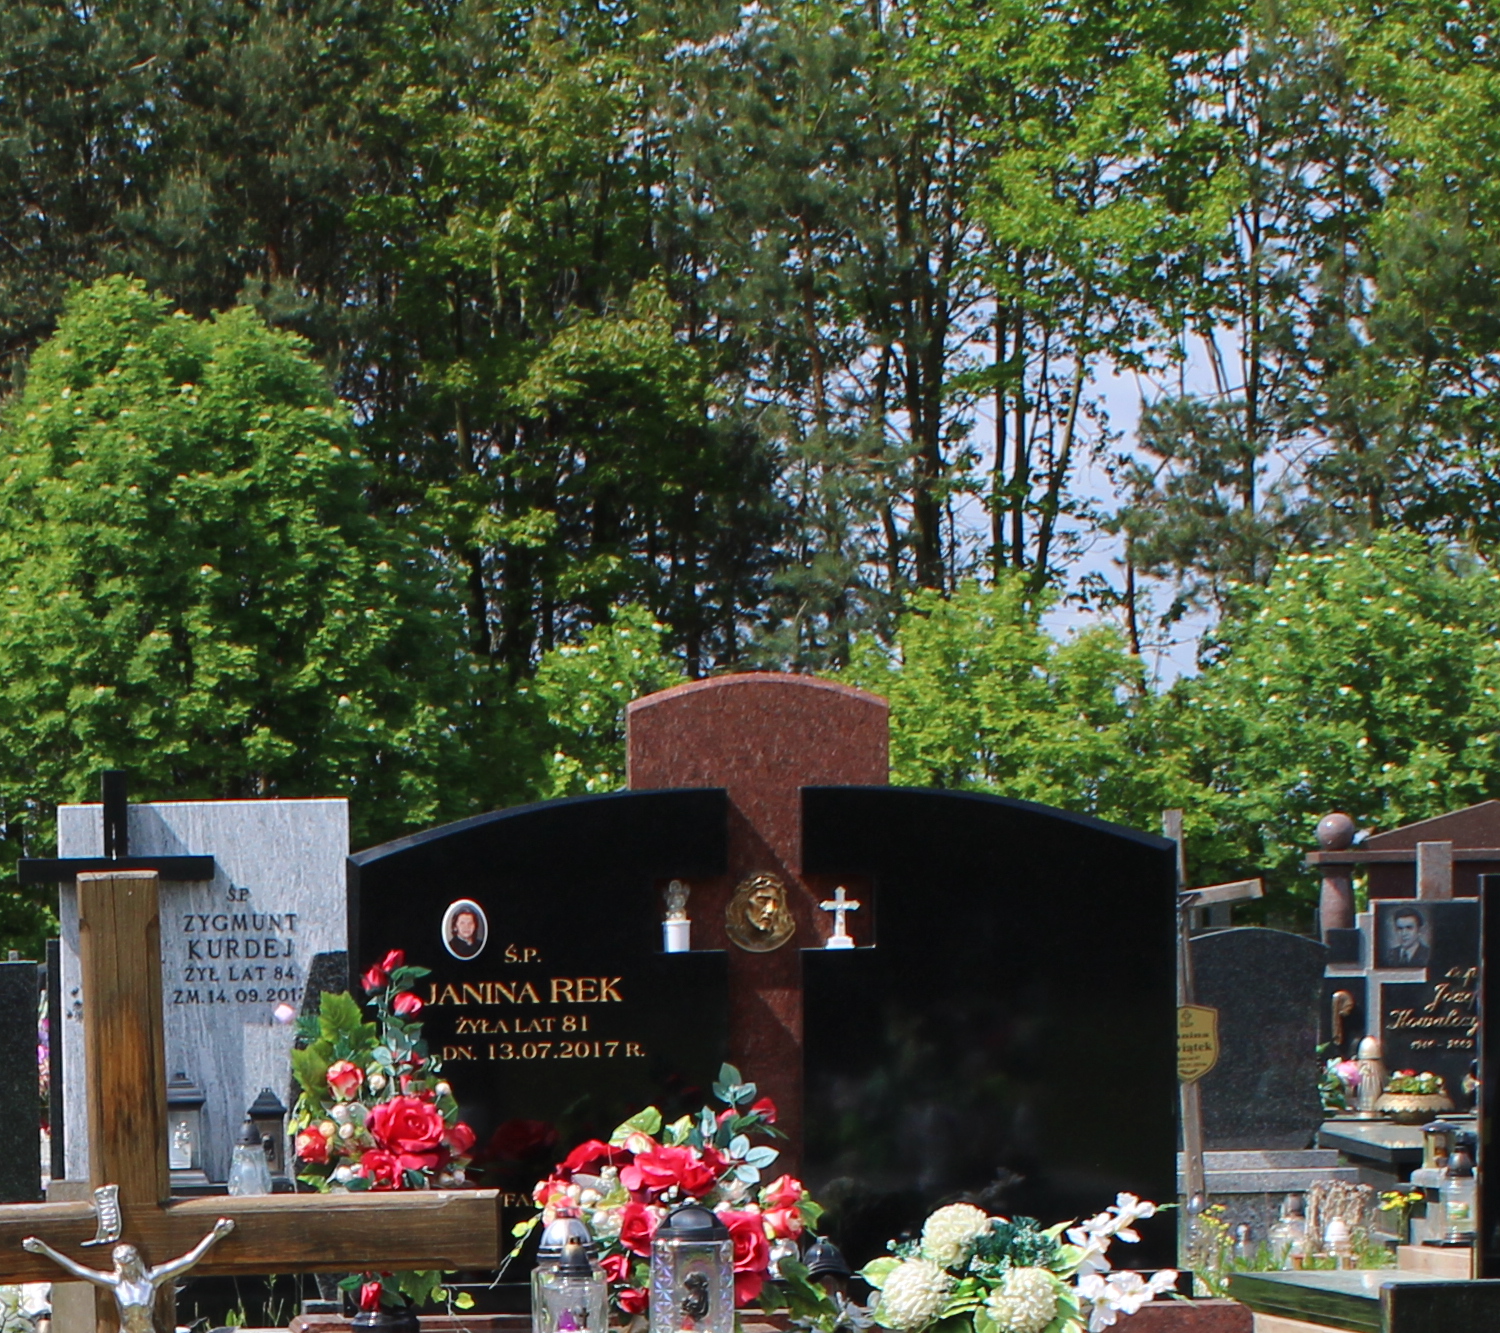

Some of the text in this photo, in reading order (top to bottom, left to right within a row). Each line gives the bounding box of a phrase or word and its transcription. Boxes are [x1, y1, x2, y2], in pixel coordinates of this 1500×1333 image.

[183, 914, 298, 932] ZYGMUNT
[188, 939, 294, 960] KURDEJ
[504, 944, 542, 963] Ś.P.
[184, 964, 295, 982] ŻYŁ LAT 84
[424, 976, 623, 1006] JANINA REK
[455, 1015, 589, 1034] ŻYŁA LAT 81
[1386, 1009, 1480, 1036] Kowalczy
[442, 1042, 646, 1061] DN. 13.07.2017 R.
